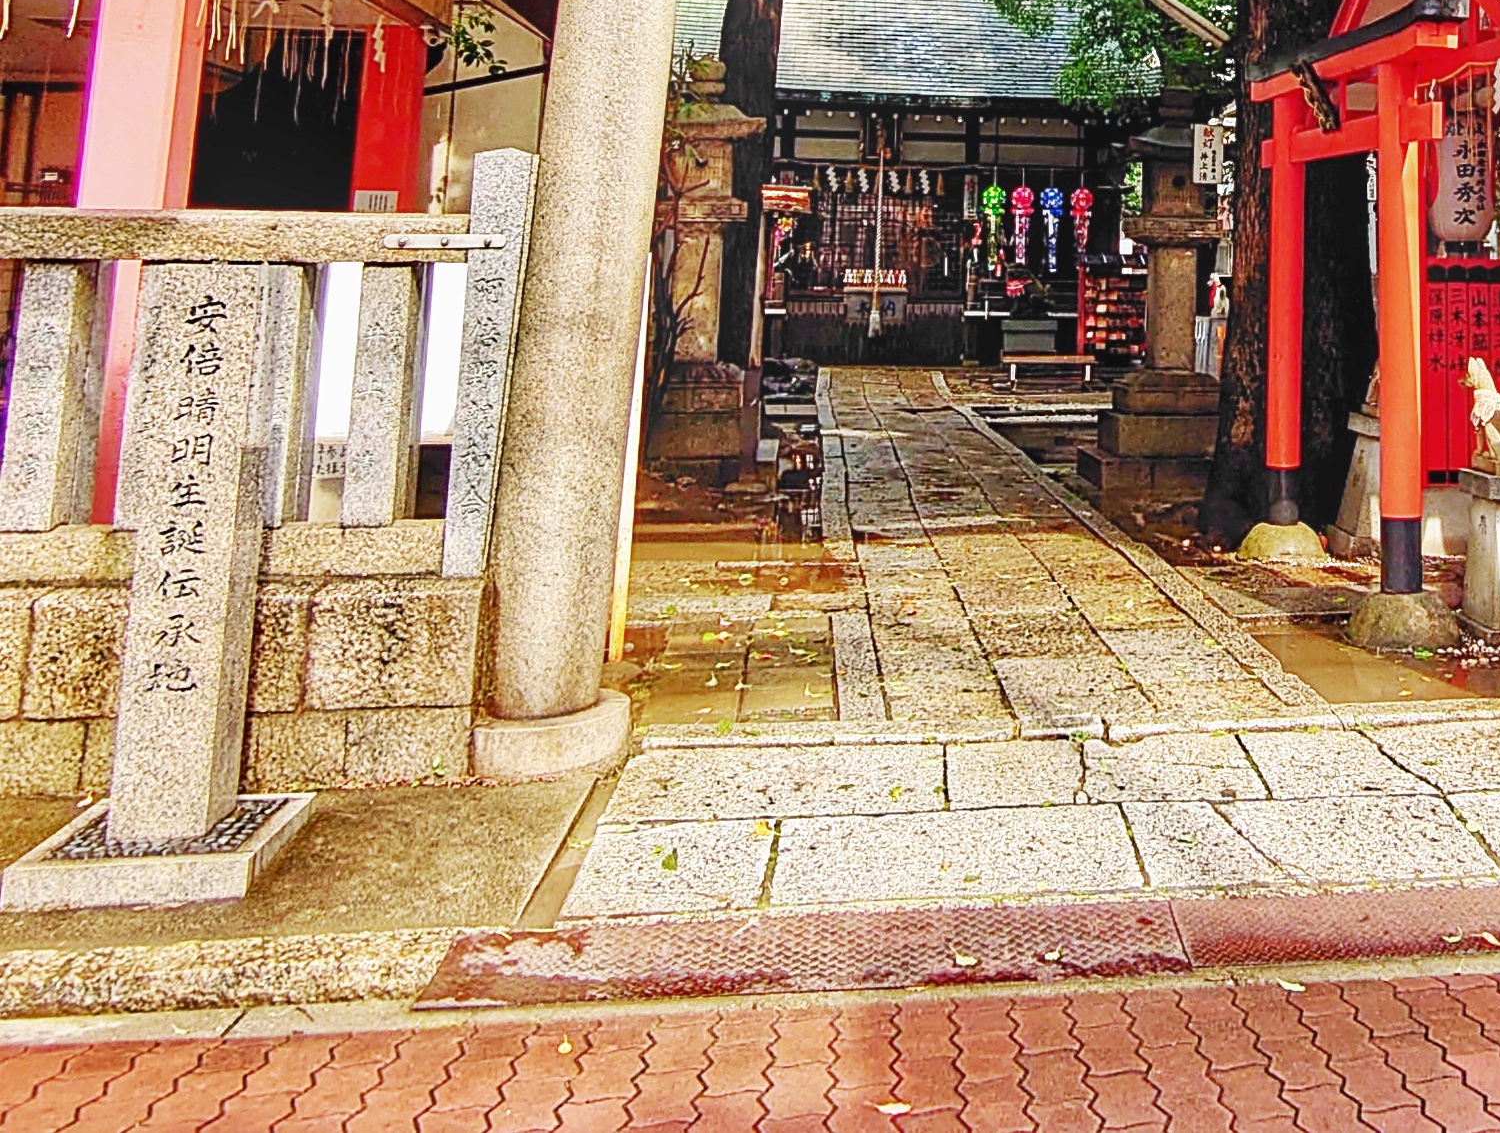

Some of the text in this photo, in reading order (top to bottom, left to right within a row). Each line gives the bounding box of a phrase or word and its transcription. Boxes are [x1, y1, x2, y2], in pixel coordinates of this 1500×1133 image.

[1453, 140, 1477, 225] 永田秀次
[146, 296, 228, 694] 安倍晴明生誕伝承地
